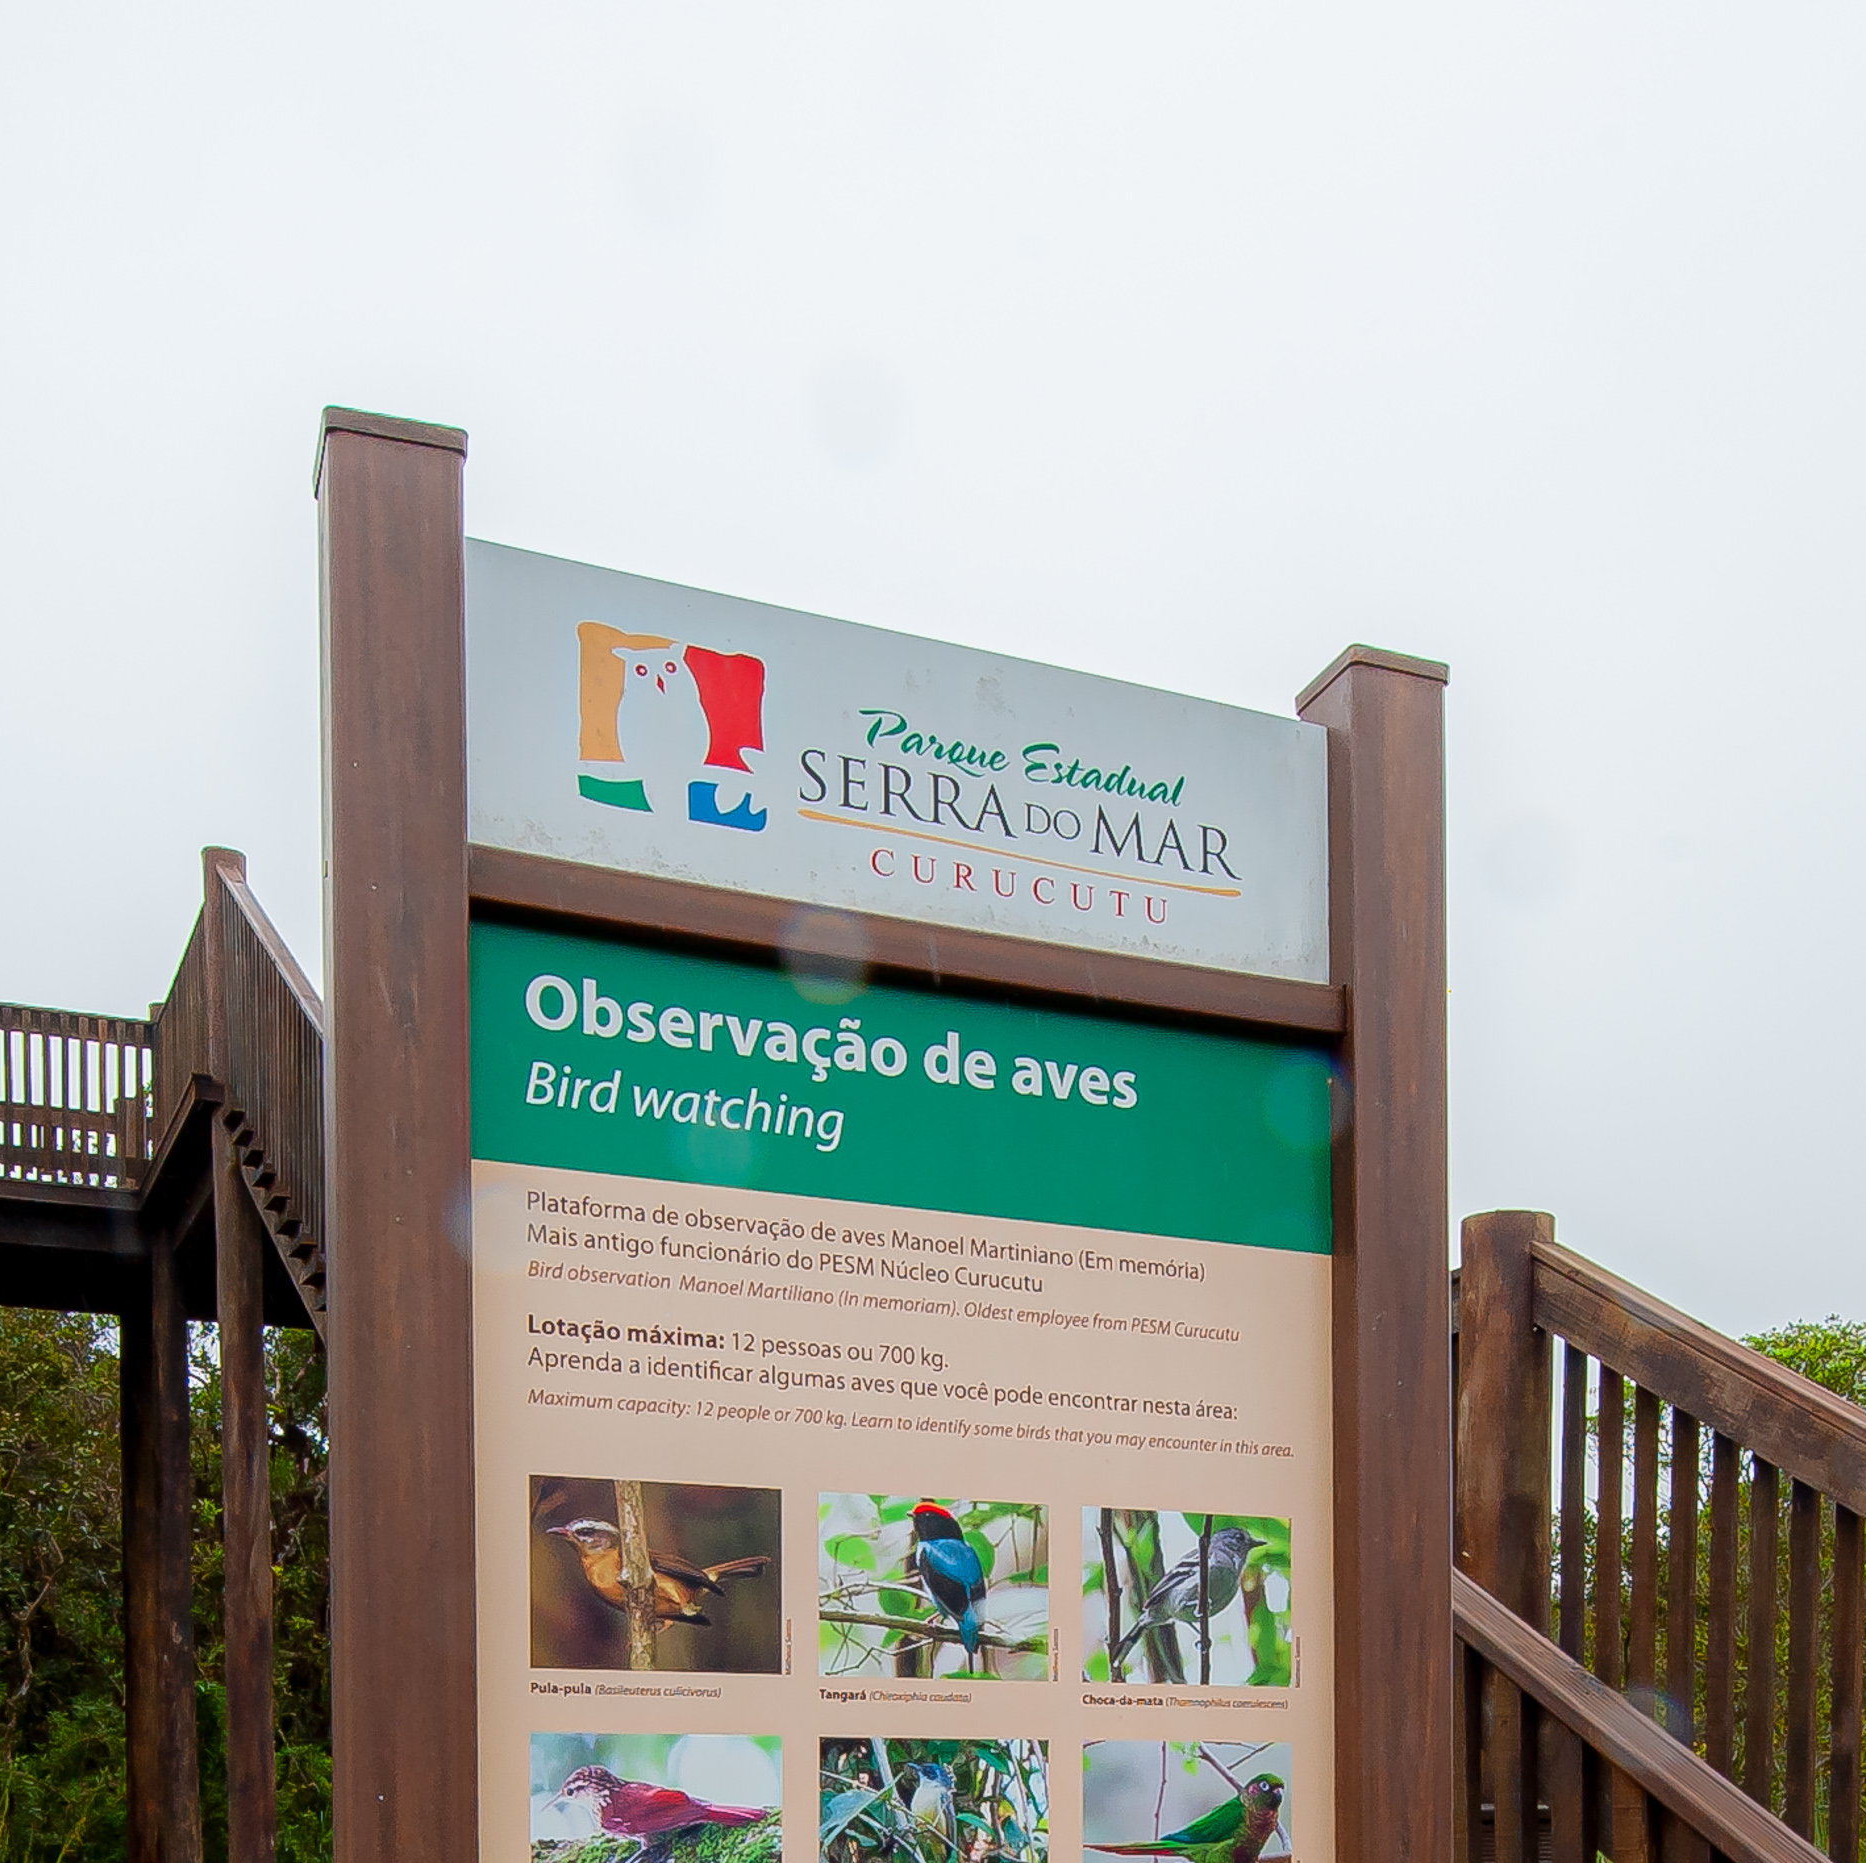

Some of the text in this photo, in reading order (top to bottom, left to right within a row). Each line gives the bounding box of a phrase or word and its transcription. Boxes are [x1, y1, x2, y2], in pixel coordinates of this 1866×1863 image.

[859, 709, 1188, 807] Parque Estadual
[798, 748, 1244, 882] SERRA DO MAR
[869, 848, 1172, 925] CURUCUTU
[525, 974, 1138, 1109] Observação de aves
[525, 1061, 845, 1150] Bird watching
[527, 1190, 1205, 1283] Plataforma de observação de aves Manoel Martiniano (Em memória)
[527, 1222, 1043, 1293] Mais antigo funcionário do PESM Núcleo Curucutu
[527, 1260, 1240, 1342] Bird observation Manoel Martiliano (In memoriam). Oldest employee from PESM Curucutu
[528, 1313, 949, 1373] Lotação máxima: 12 pessoas ou 700 kg.
[527, 1346, 1238, 1420] Aprenda a identificar algumas aves que você pode encontrar nesta área:
[527, 1388, 1295, 1458] Maximum capacity: 12 people or 700 kg. Learn to identify some birds that you may encounter in this area.
[529, 1681, 592, 1698] Pula-pula
[818, 1688, 867, 1703] Tangará
[1082, 1694, 1164, 1706] Choca-da-mata
